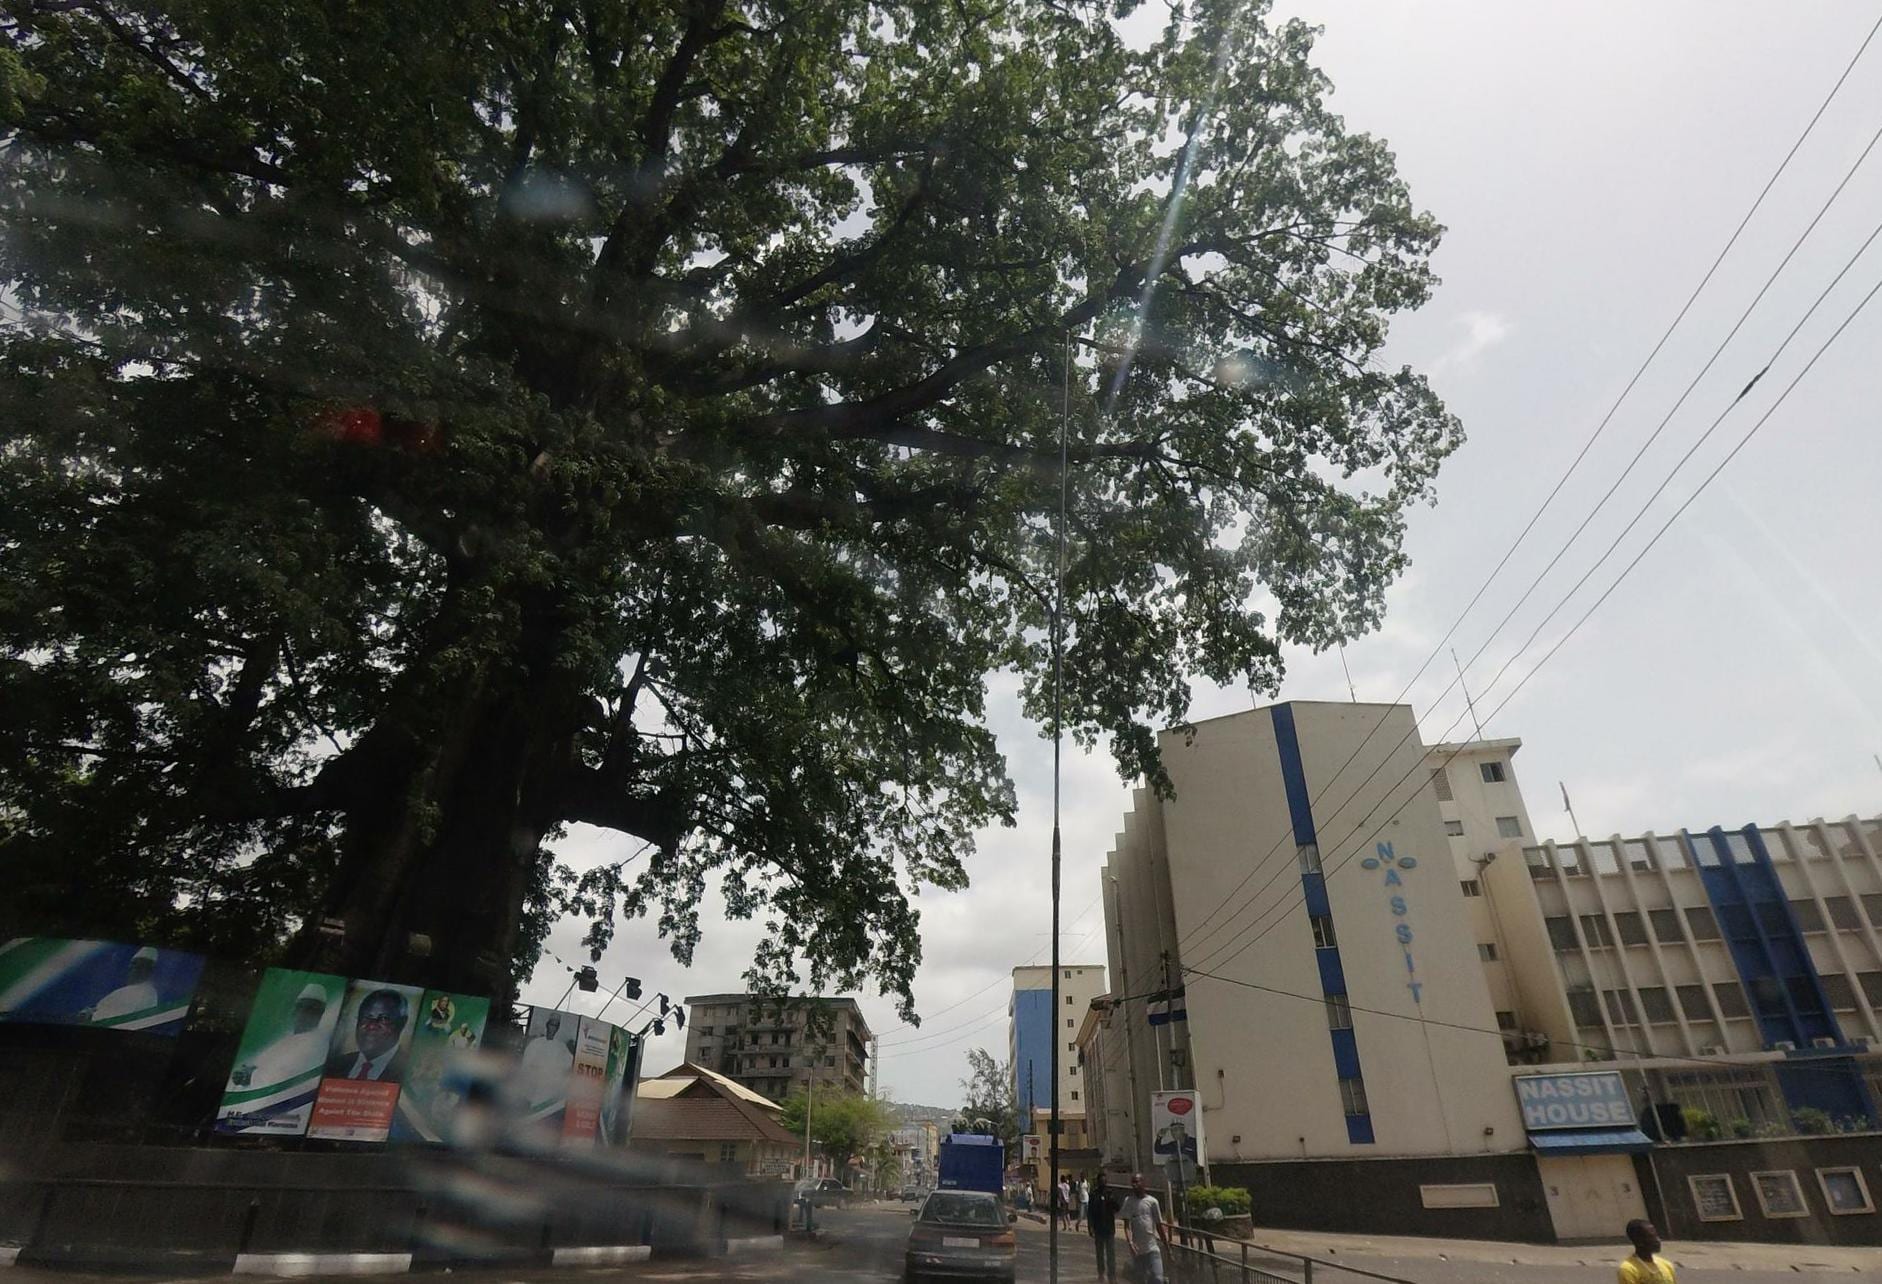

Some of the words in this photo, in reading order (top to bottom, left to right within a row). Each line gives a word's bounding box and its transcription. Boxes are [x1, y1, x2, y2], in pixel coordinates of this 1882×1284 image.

[577, 1063, 604, 1078] STOP
[1519, 1075, 1618, 1099] NASSIT
[1525, 1101, 1630, 1125] HOUSE
